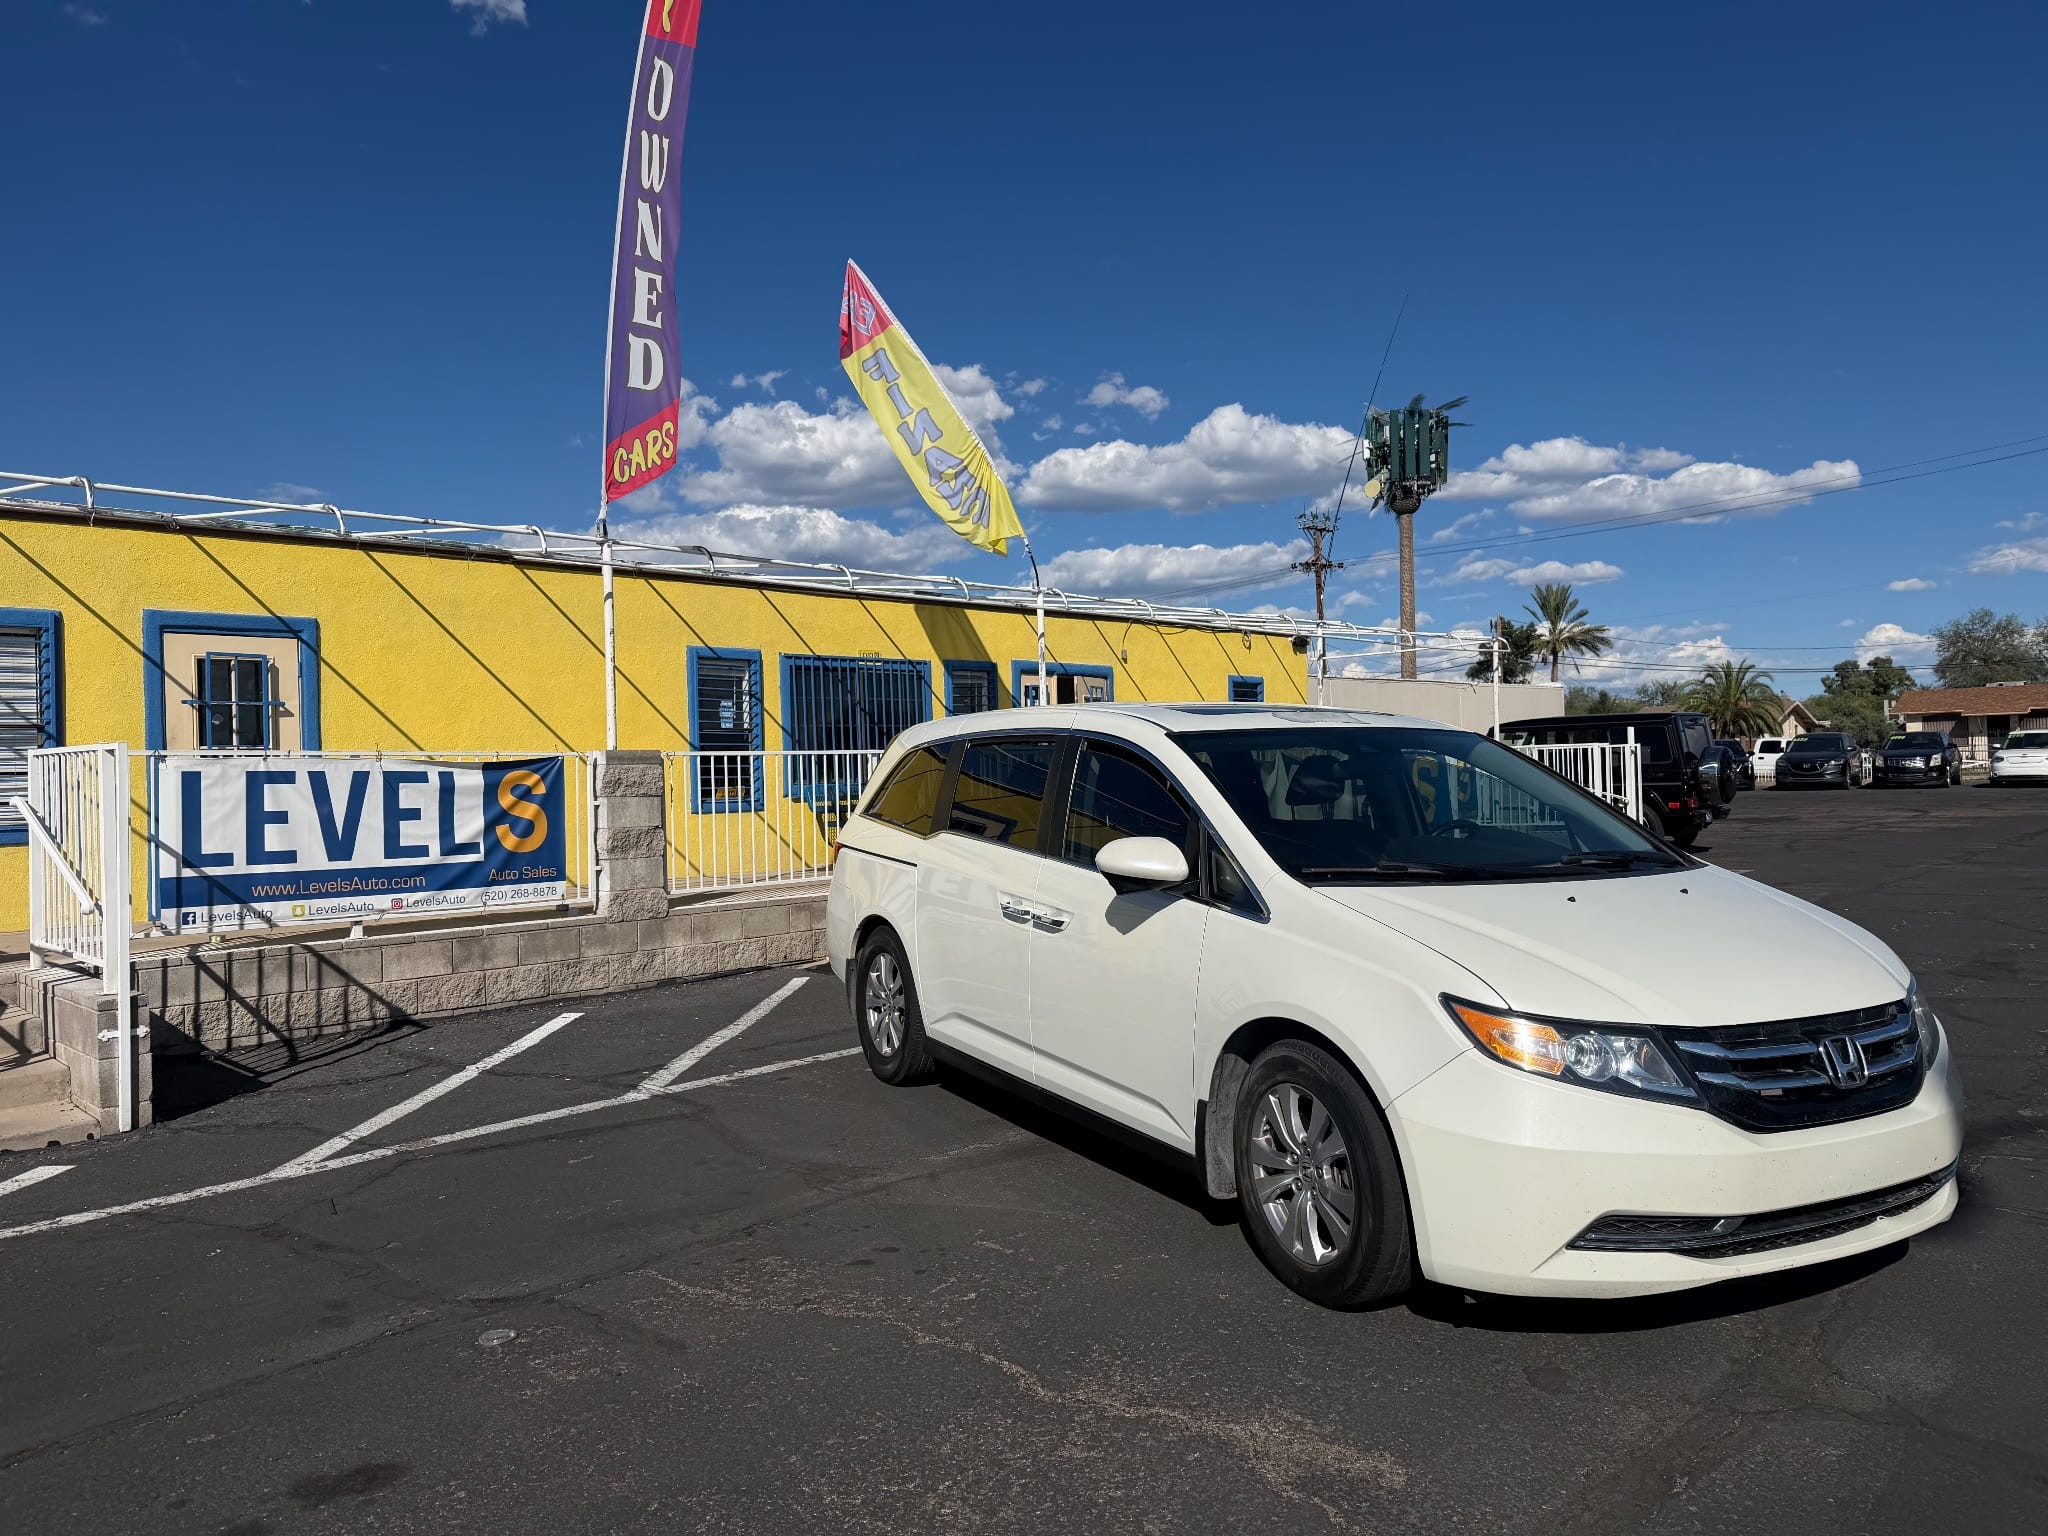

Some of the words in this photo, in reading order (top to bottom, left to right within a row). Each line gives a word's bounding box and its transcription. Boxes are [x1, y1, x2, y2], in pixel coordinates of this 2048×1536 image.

[627, 55, 674, 391] OWNED
[613, 420, 675, 483] CARS
[181, 770, 548, 868] LEVELS
[488, 868, 519, 882] Auto
[522, 866, 557, 879] Sales
[252, 875, 427, 898] www.LevelsAuto.com
[480, 889, 508, 902] (520)
[510, 886, 558, 900] 268-8878
[308, 901, 375, 916] LevelsAuto
[406, 894, 466, 908] LevelsAuto
[200, 908, 273, 923] LevelsAuto
